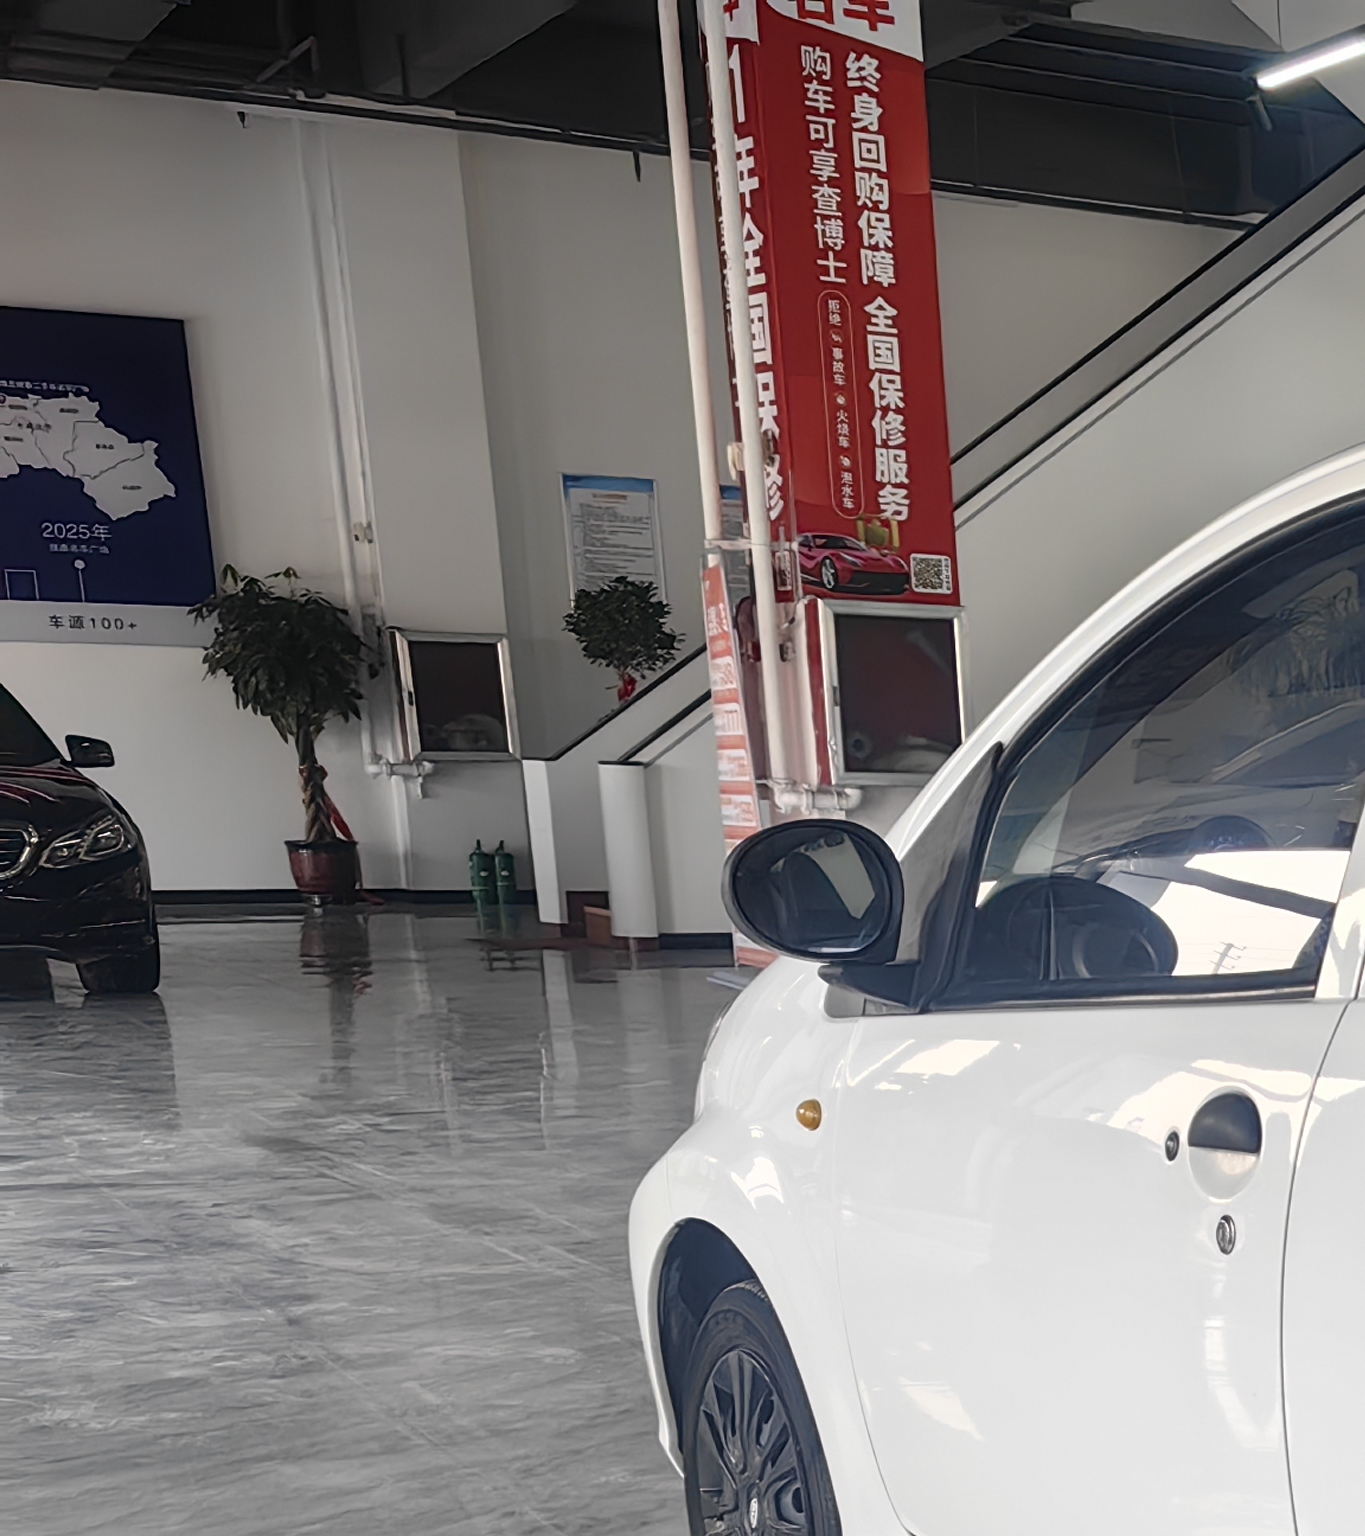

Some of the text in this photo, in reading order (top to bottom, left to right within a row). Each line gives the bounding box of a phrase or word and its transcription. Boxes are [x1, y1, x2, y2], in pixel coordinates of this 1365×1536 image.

[800, 45, 848, 285] 购车可享查博士
[845, 51, 910, 521] 终身回购保障 全国保修服务
[836, 410, 851, 449] 火烧车
[840, 470, 855, 510] 泡水车
[40, 522, 113, 542] 2025年
